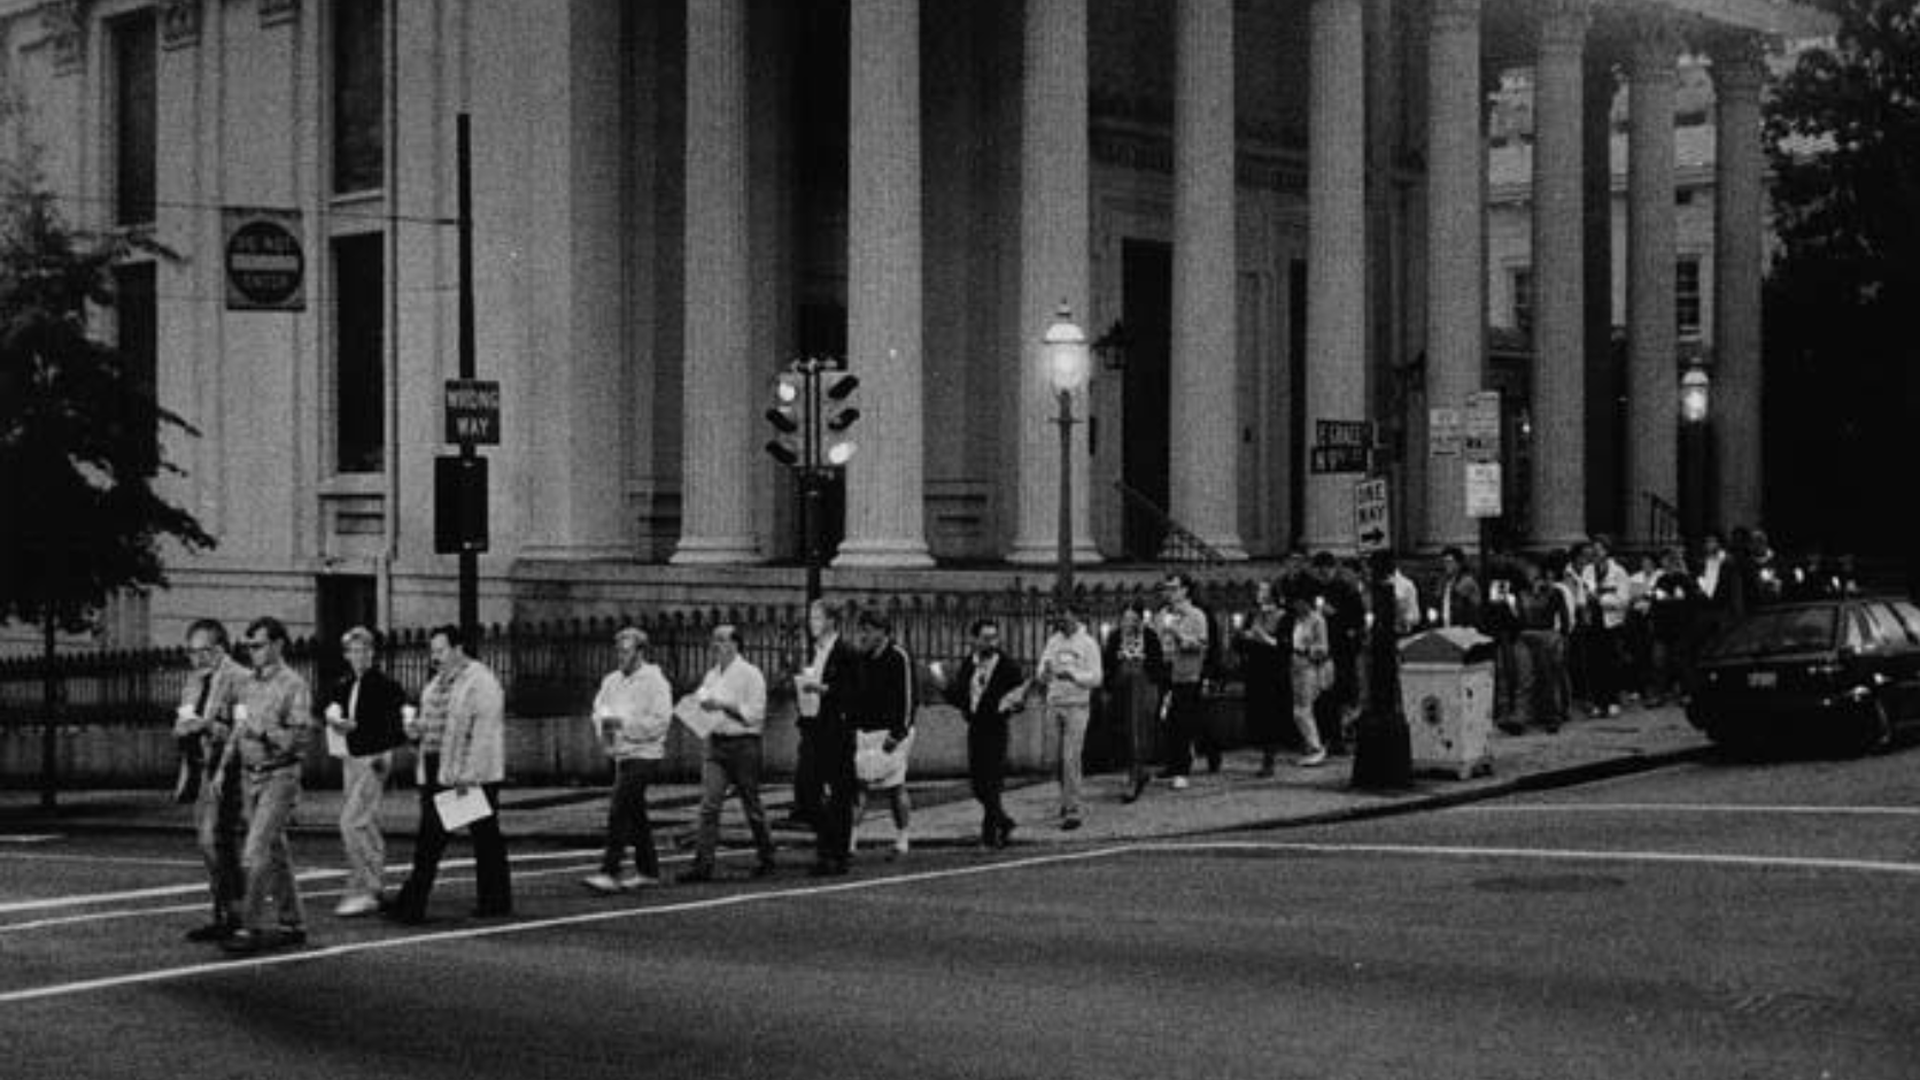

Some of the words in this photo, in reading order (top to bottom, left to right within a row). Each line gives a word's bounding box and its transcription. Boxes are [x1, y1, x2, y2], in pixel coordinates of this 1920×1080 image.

[447, 389, 499, 409] WRONG
[456, 416, 490, 437] WAY
[1358, 482, 1385, 504] ONE
[1358, 506, 1385, 525] WAY
